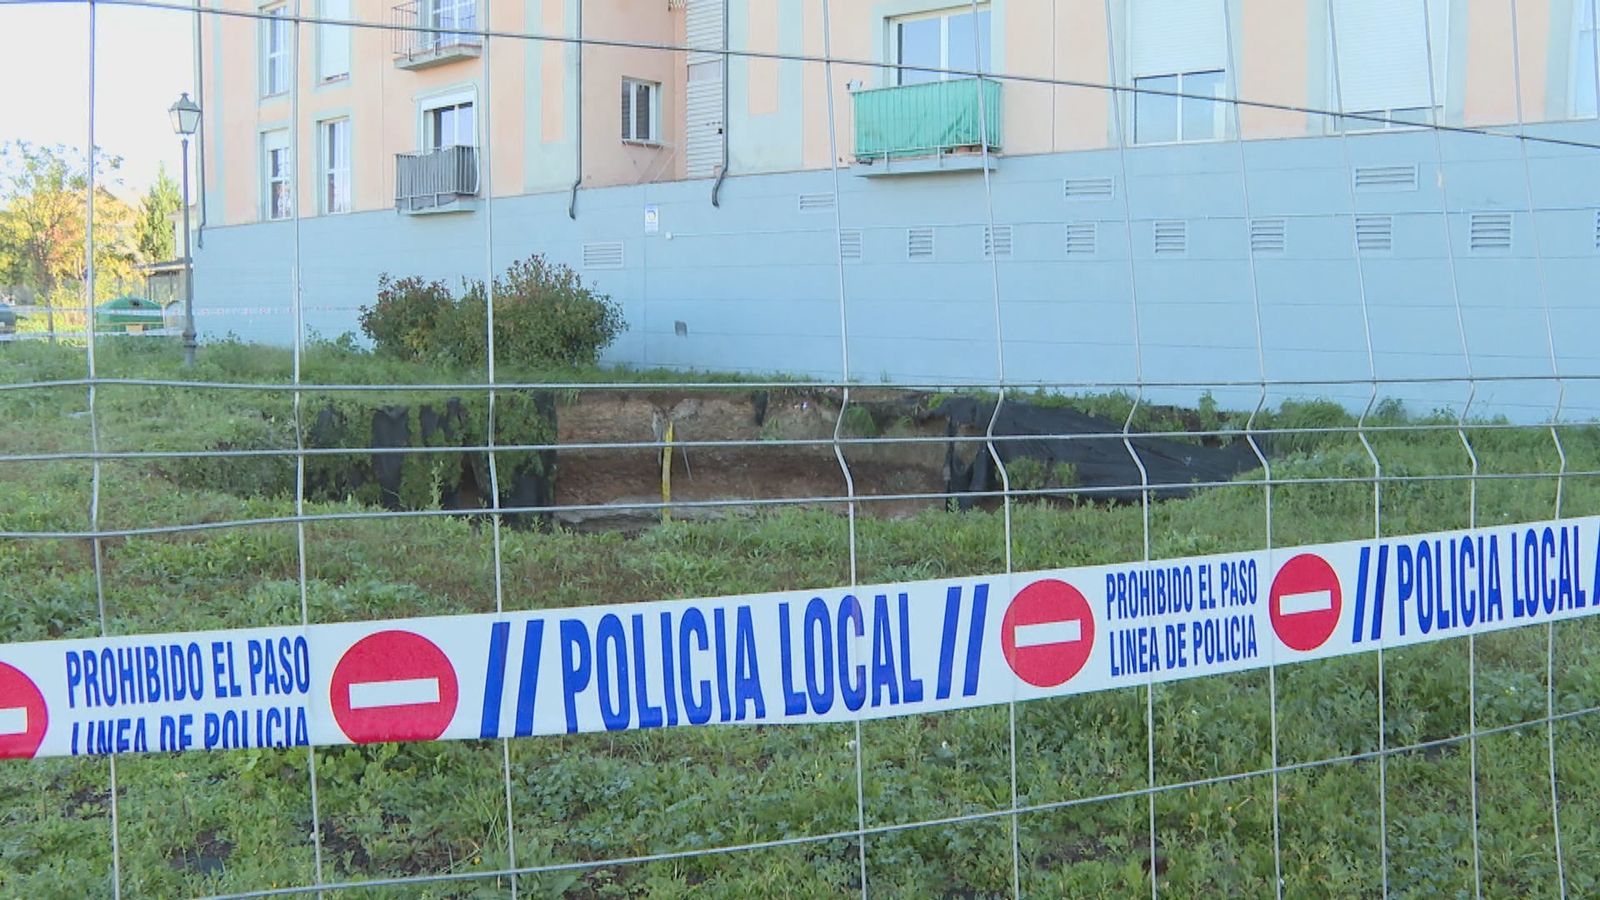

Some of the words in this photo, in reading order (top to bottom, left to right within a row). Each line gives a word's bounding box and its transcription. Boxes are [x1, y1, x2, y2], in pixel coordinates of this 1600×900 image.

[1105, 565, 1194, 620] PROHIBIDO
[1198, 563, 1217, 611] EL
[1220, 559, 1258, 608] PASO
[1397, 534, 1504, 636] POLICIA
[1510, 524, 1587, 619] LOCAL
[66, 642, 204, 708] PROHIBIDO
[211, 640, 242, 699] EL
[248, 635, 311, 697] PASO
[560, 605, 766, 734] POLICIA
[779, 592, 924, 717] LOCAL
[1110, 626, 1160, 677] LINEA
[1165, 622, 1188, 670] DE
[1193, 613, 1258, 666] POLICIA
[160, 713, 194, 752] DE
